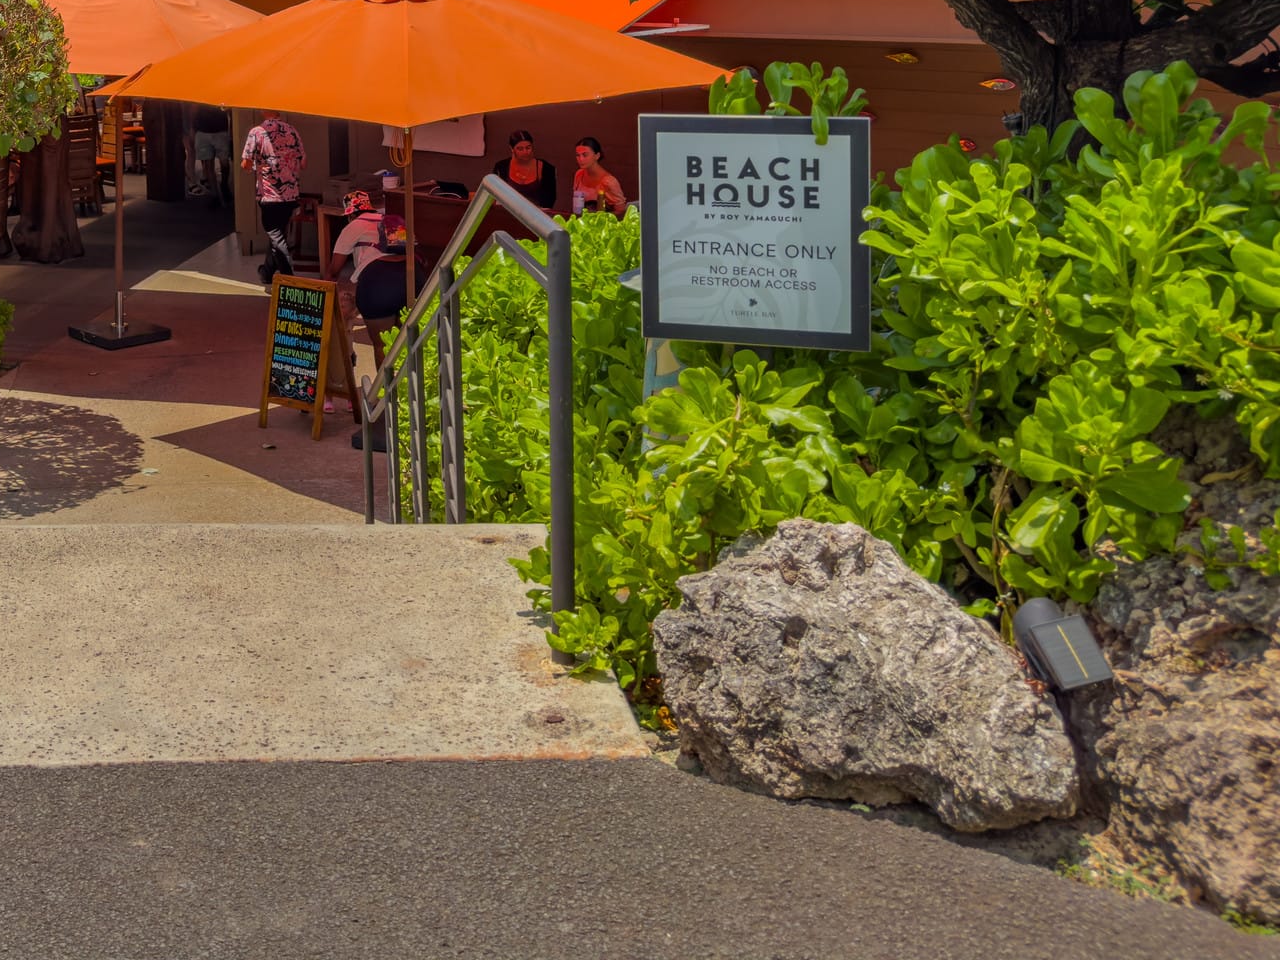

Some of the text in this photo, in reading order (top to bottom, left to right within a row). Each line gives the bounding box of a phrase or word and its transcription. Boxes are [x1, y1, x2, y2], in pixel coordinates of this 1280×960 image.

[686, 155, 820, 181] BEACH
[686, 183, 820, 209] HOUSE
[744, 214, 803, 223] YAMAGUCHI
[672, 240, 837, 260] ENTRANCE ONLY
[709, 265, 797, 278] NO BEACH OR
[691, 276, 817, 291] RESTROOM ACCESS
[280, 286, 285, 300] E
